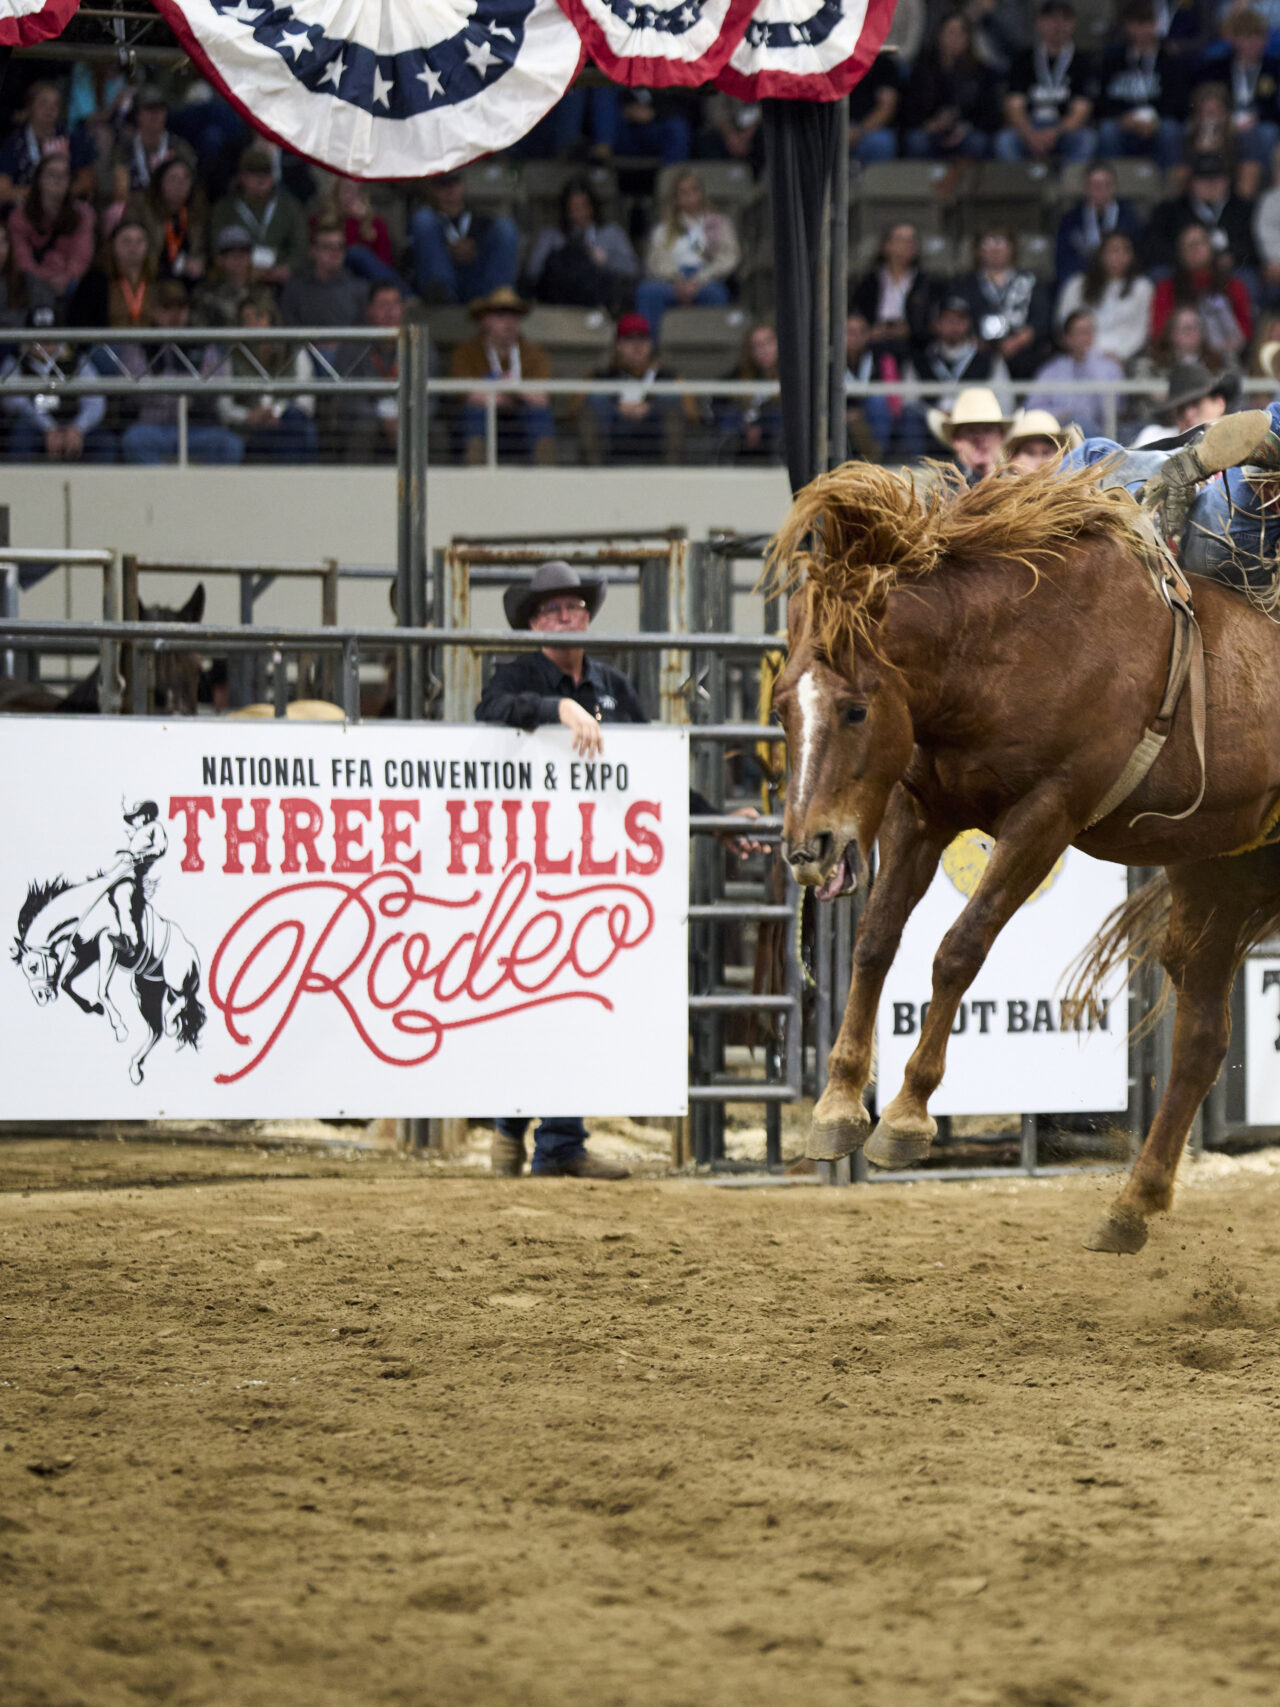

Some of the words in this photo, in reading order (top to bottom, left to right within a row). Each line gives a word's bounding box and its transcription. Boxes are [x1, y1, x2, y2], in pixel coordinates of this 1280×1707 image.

[201, 755, 321, 788] NATIONAL
[330, 757, 374, 789] FFA
[383, 758, 533, 791] CONVENTION
[543, 762, 559, 792] &
[569, 761, 630, 792] EXPO
[169, 795, 422, 874] THREE
[445, 798, 666, 876] HILLS
[208, 861, 656, 1084] Rodeo
